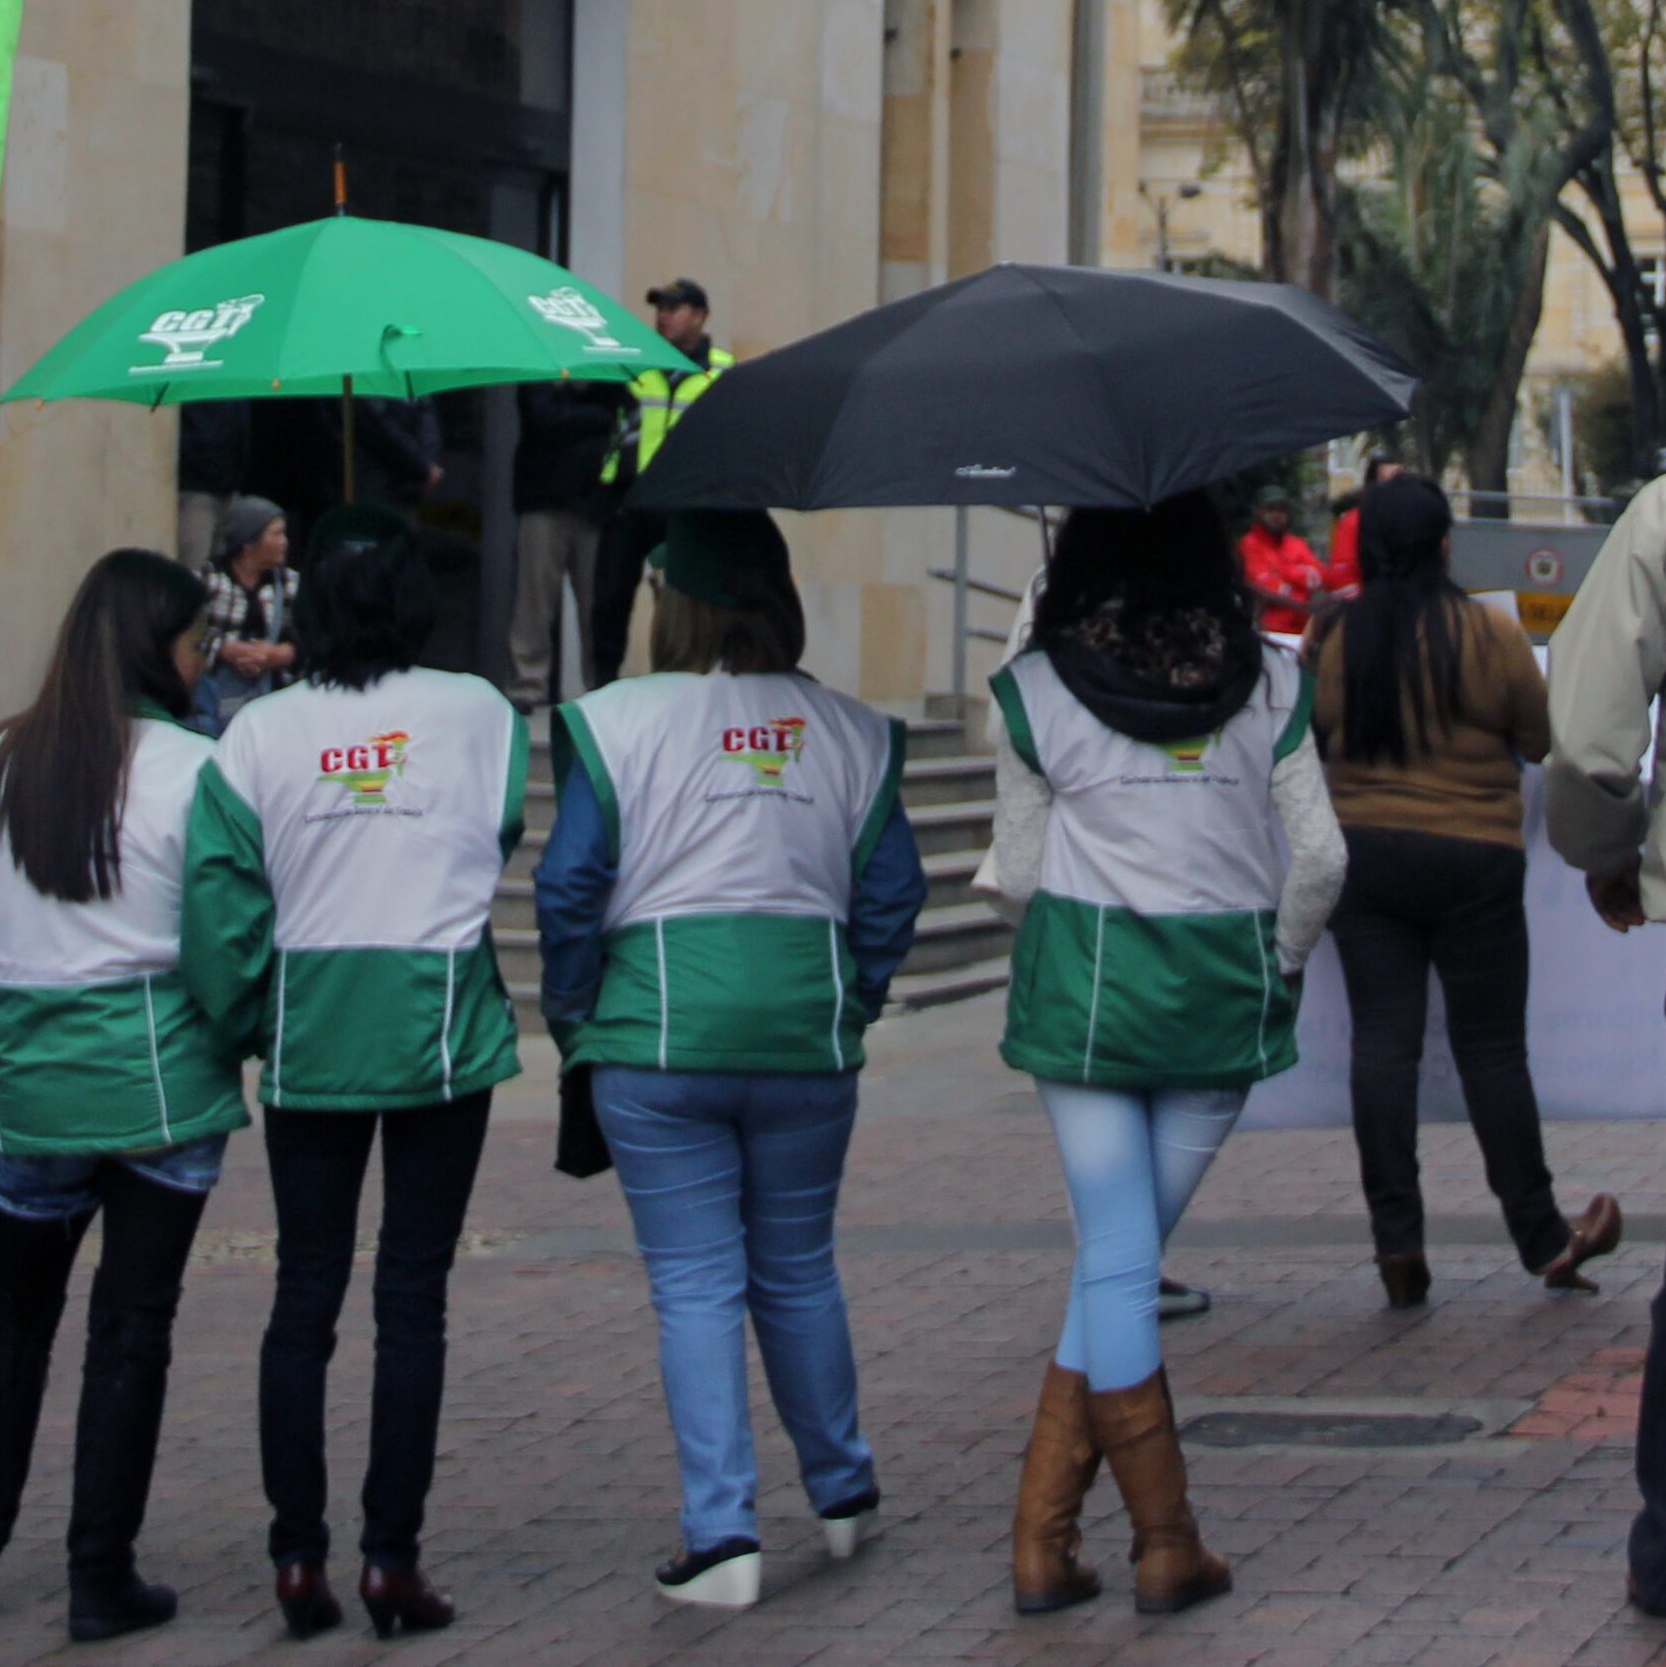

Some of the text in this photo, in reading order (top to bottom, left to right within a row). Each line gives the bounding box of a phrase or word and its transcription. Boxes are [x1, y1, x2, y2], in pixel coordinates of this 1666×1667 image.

[149, 303, 239, 333] CGT
[722, 726, 792, 752] CGT
[320, 743, 394, 773] CGT
